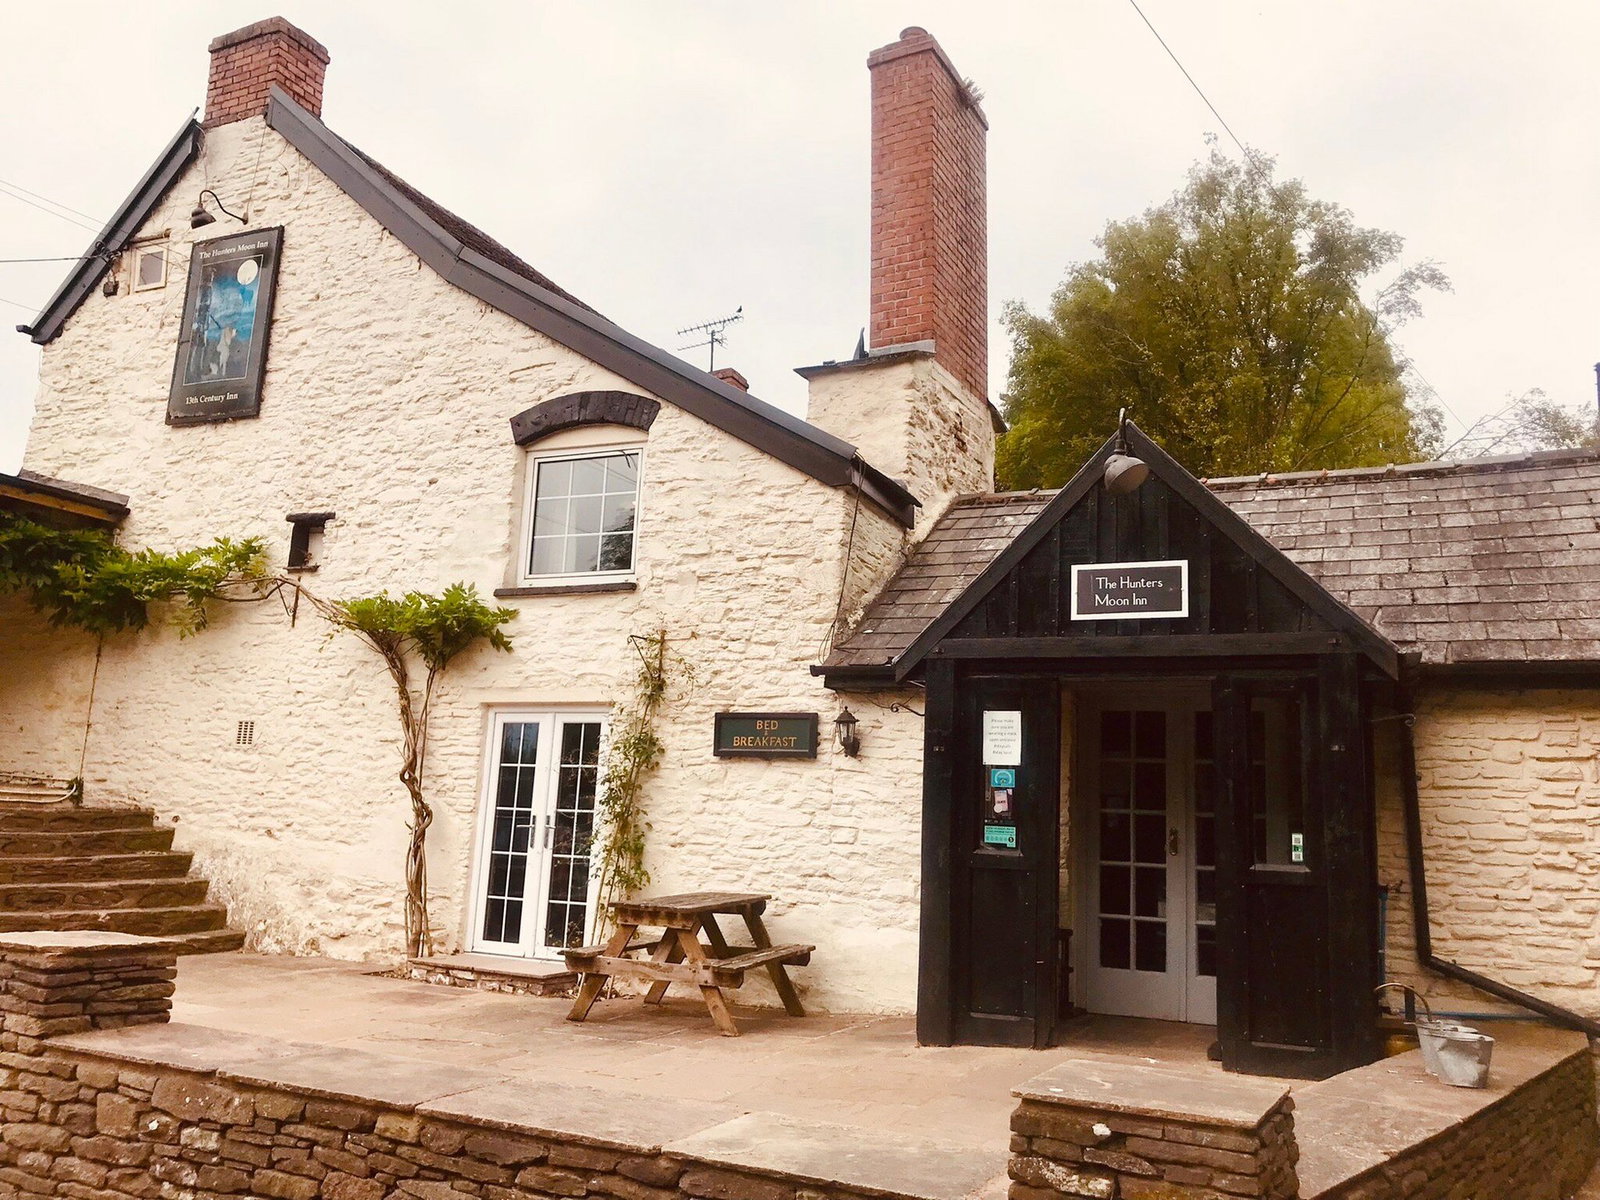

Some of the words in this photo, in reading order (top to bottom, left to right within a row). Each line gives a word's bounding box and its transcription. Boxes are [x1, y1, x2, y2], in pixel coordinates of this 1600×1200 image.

[212, 247, 236, 257] Hunters
[237, 244, 256, 252] Moon
[185, 396, 199, 405] 13th
[199, 394, 225, 403] Century
[226, 392, 238, 400] Inn
[1095, 577, 1117, 589] The
[1120, 576, 1163, 589] Hunters
[1095, 593, 1129, 606] Moon
[1132, 593, 1147, 605] Inn
[756, 720, 779, 730] BED
[733, 736, 797, 747] BREAKFAST
